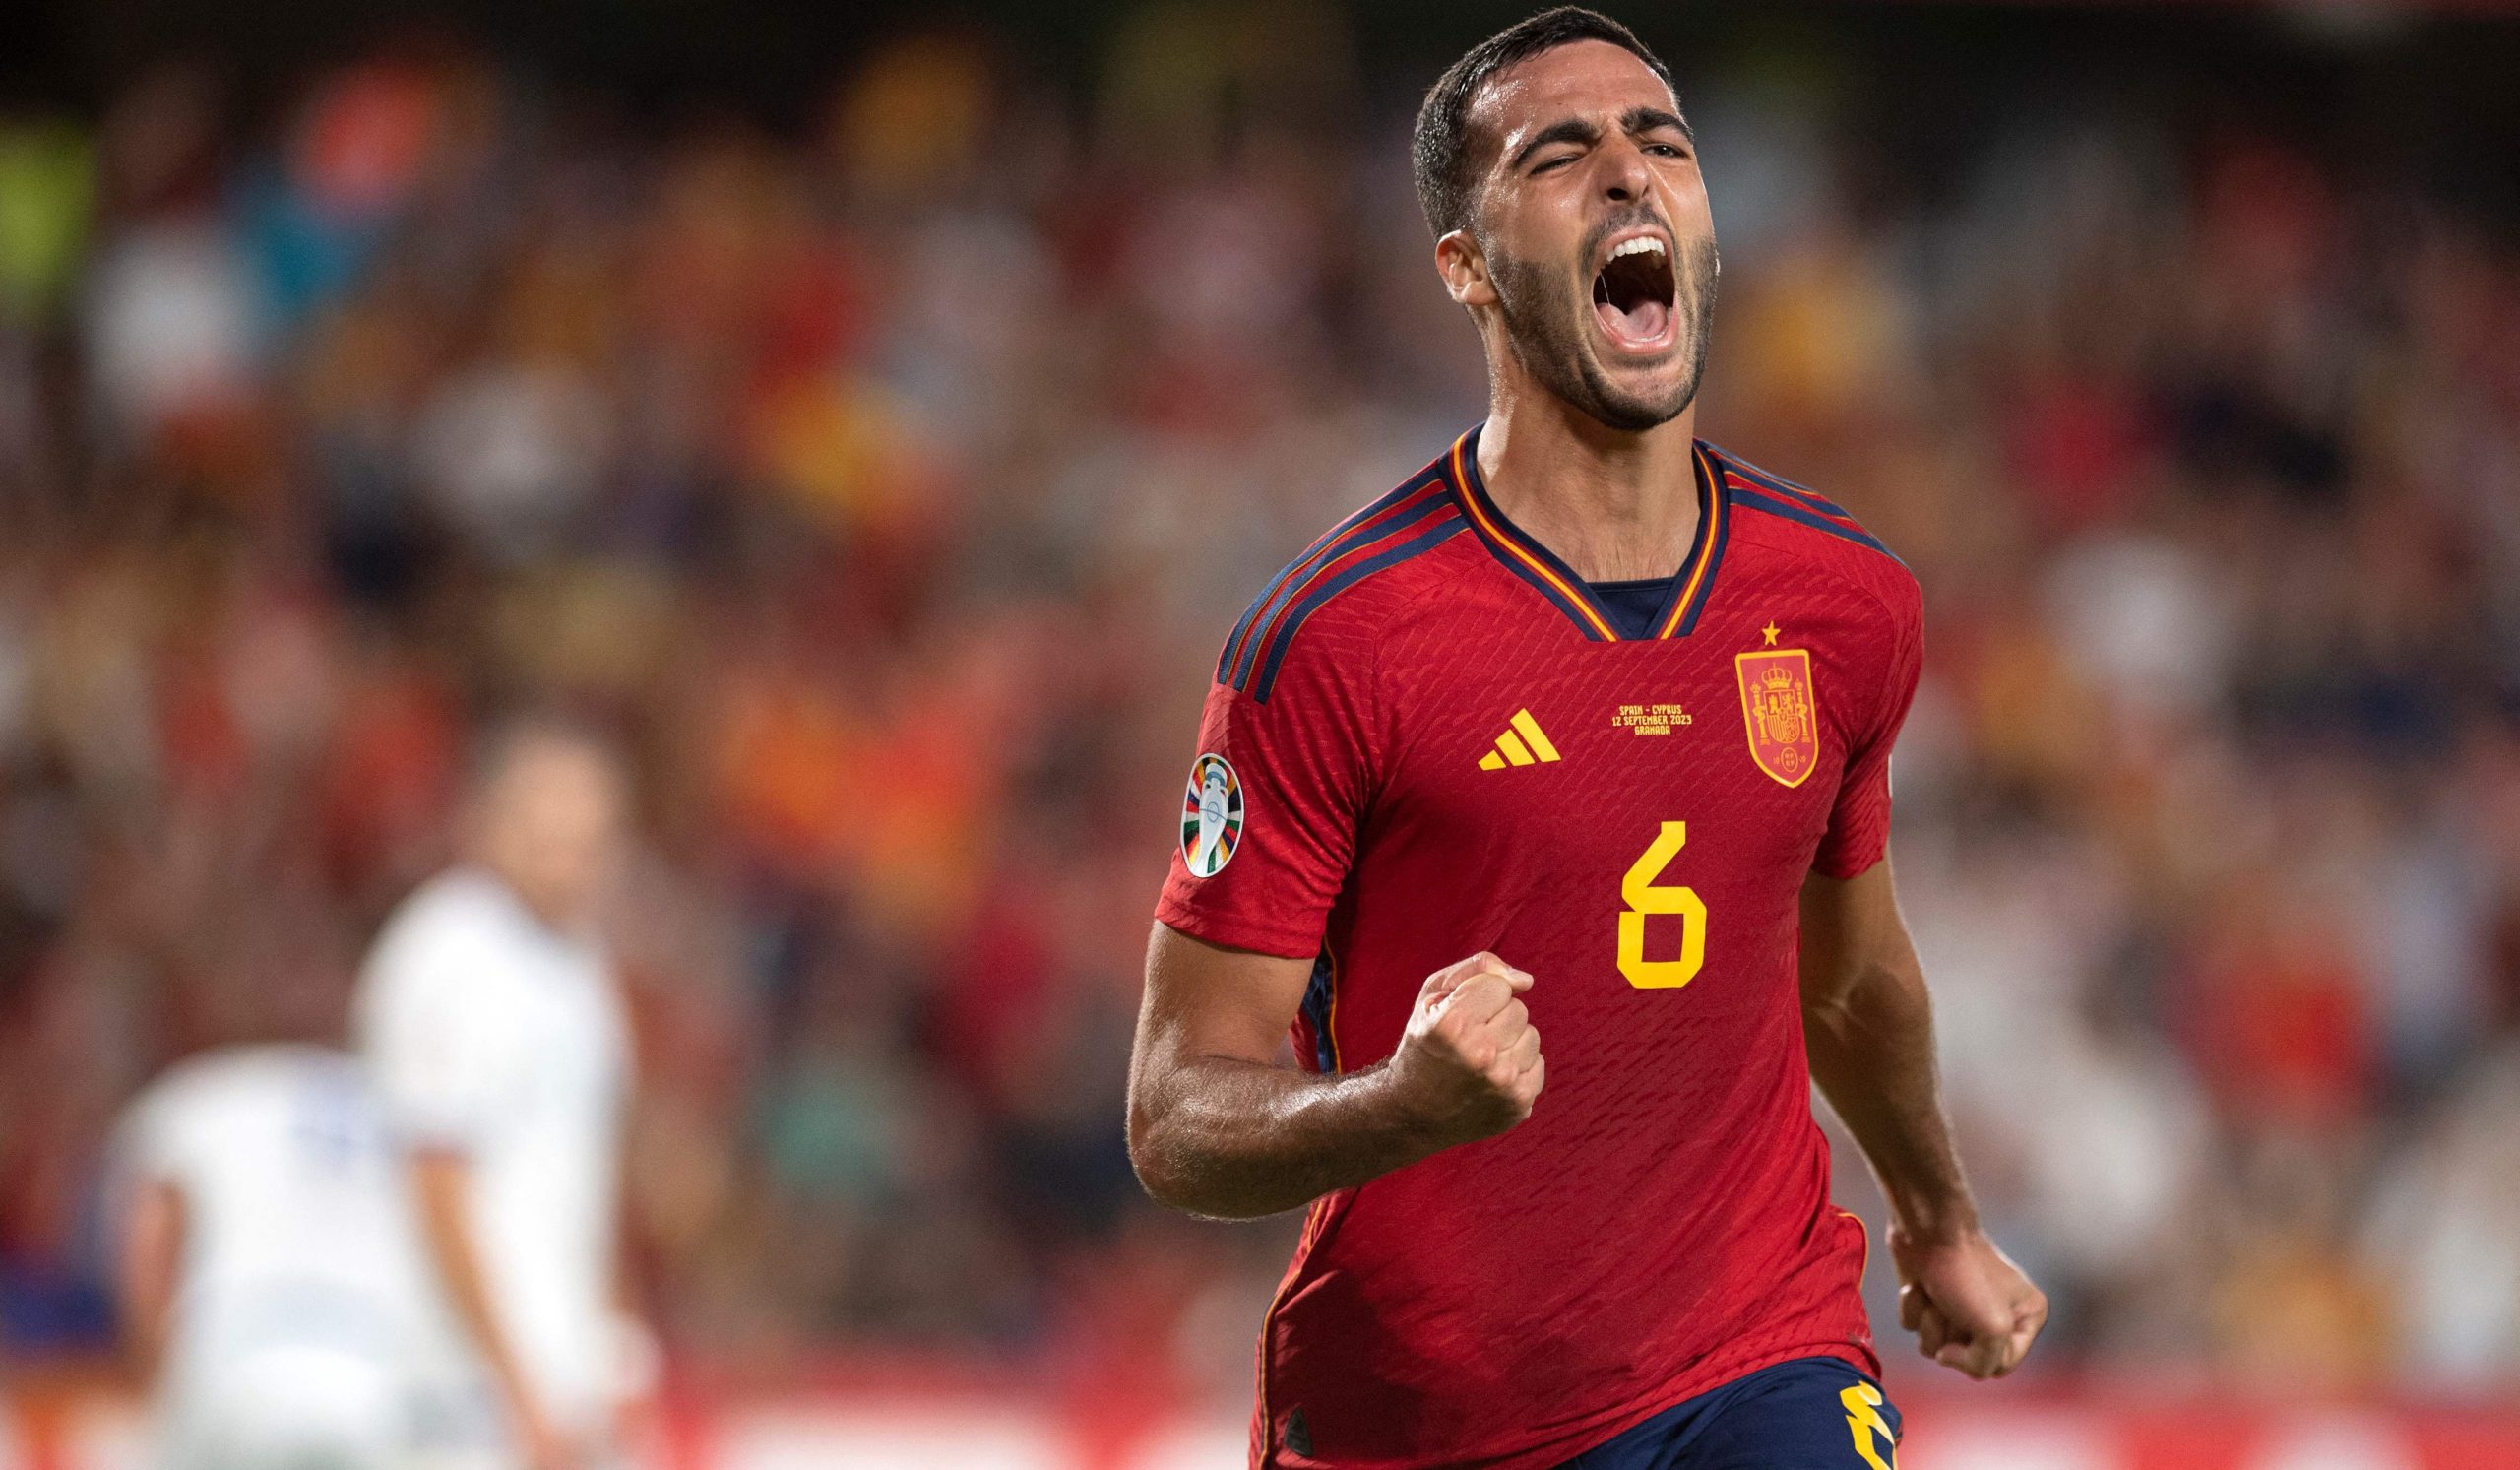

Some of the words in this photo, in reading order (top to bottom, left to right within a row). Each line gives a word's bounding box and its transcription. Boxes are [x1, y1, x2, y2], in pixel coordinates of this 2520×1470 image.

[1619, 705, 1643, 716] SPAIN
[1652, 704, 1682, 715] CYPRUS
[1612, 716, 1622, 727] 12
[1623, 715, 1669, 726] SEPTEMBER
[1670, 714, 1692, 725] 2023
[1634, 725, 1670, 735] GRANADA
[1616, 820, 1708, 990] 6
